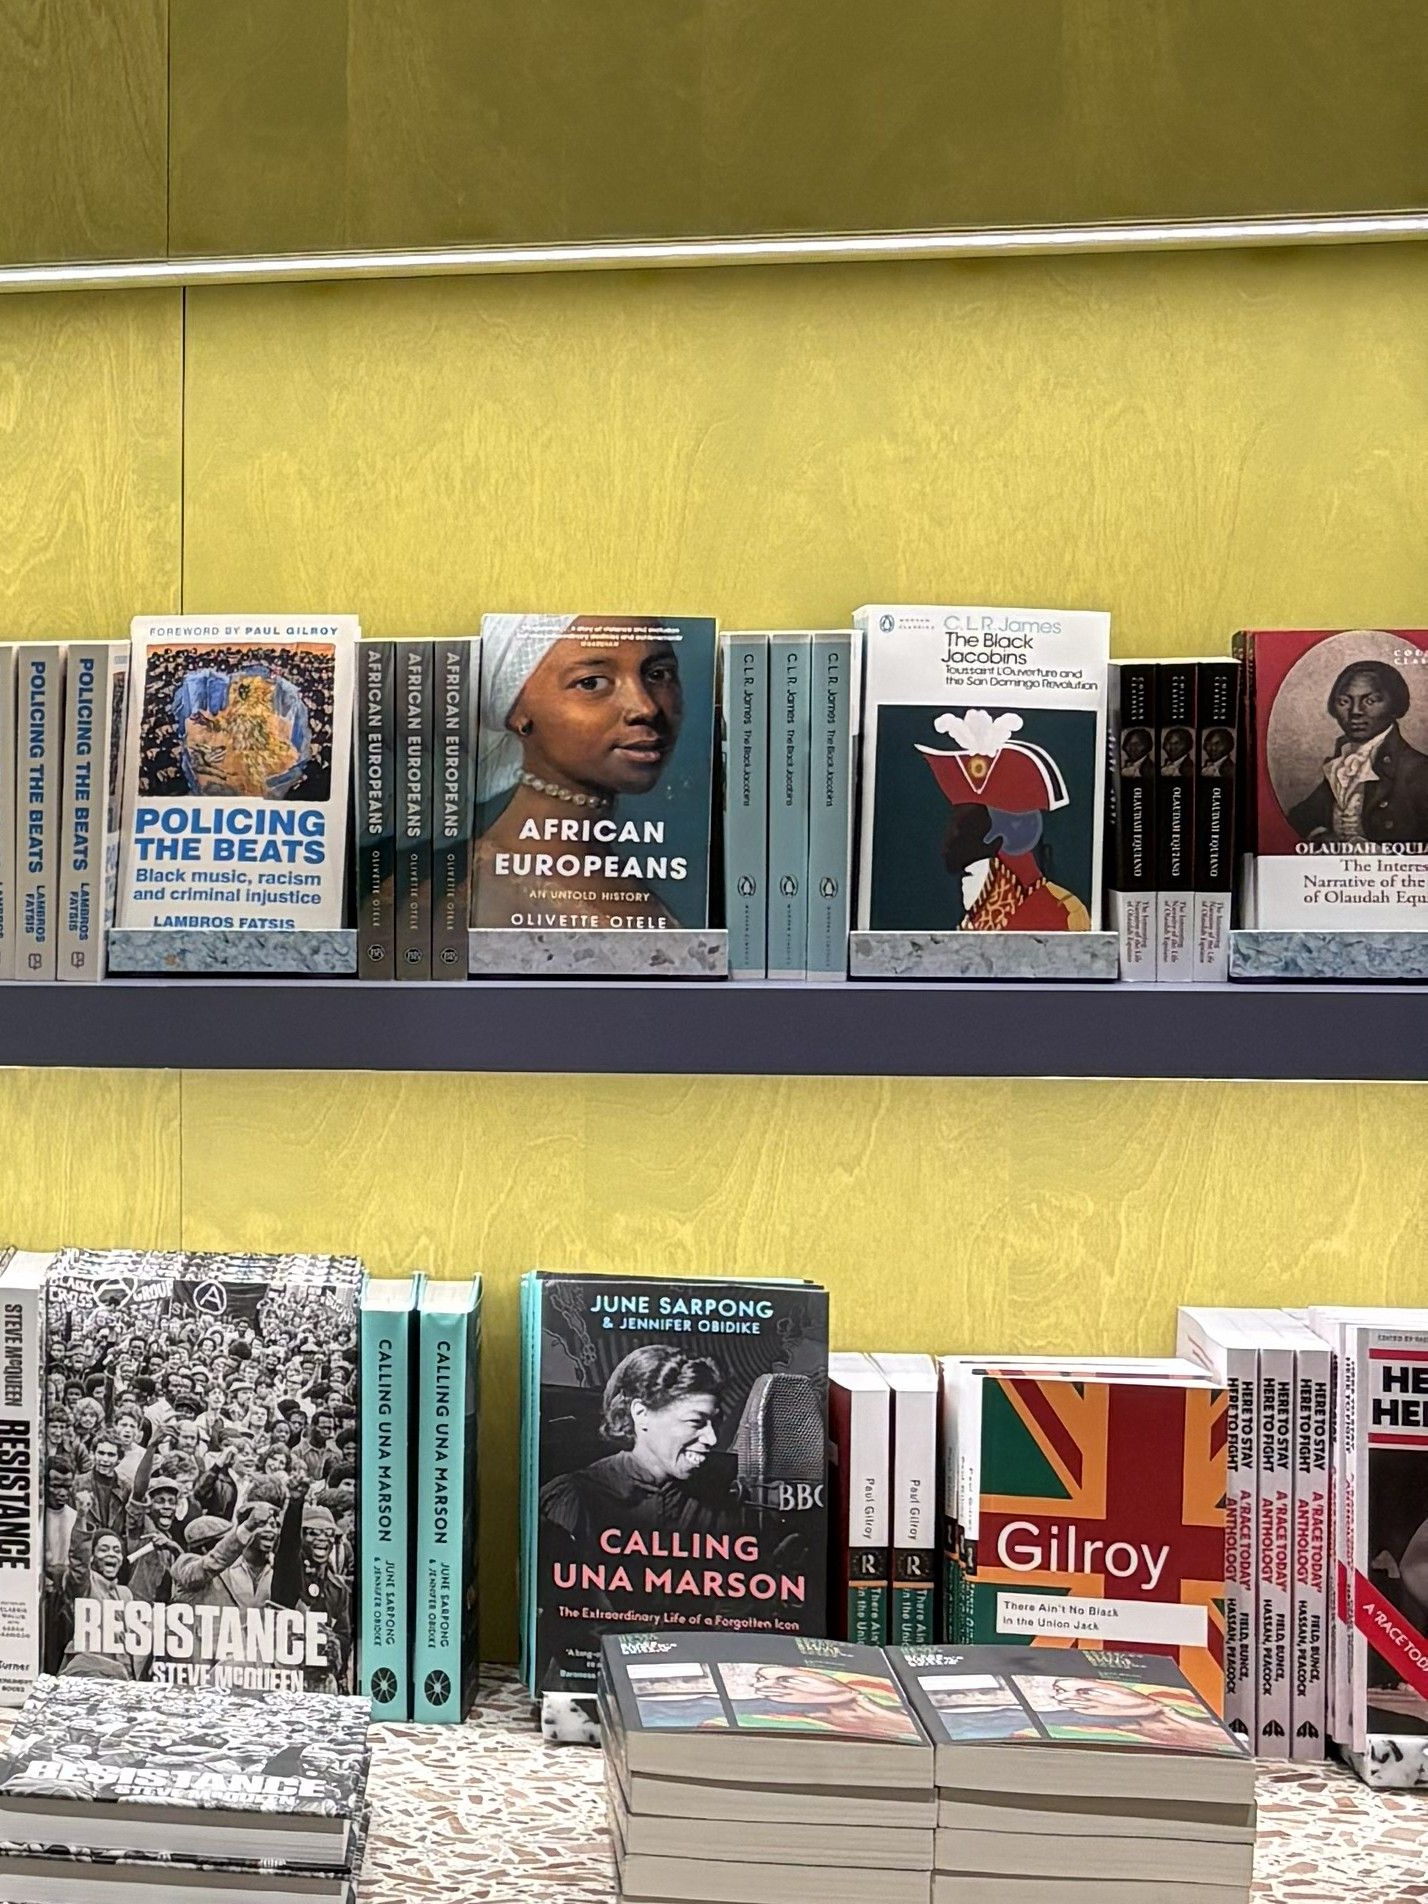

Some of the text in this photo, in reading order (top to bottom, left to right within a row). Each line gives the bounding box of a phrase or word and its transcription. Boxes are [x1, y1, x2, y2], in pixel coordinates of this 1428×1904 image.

[150, 626, 339, 636] FOREWORD BY PAUL GILROY
[945, 632, 1033, 650] The Black
[941, 649, 1027, 665] Jacobins
[367, 650, 383, 835] AFRICAN EUROPEANS
[135, 807, 326, 837] POLICING
[518, 818, 665, 844] AFRICAN
[134, 837, 325, 864] THE BEATS
[1295, 841, 1428, 856] OLAUDAH EQUI
[495, 853, 688, 880] EUROPEANS
[1340, 859, 1371, 872] The
[136, 868, 321, 887] Black music, racism
[1304, 875, 1425, 888] Narrative of the
[133, 887, 321, 905] and criminal injustice
[529, 891, 650, 902] AN UNTOLD HISTORY
[1304, 890, 1322, 904] of
[1330, 890, 1390, 904] Olaudah
[153, 915, 295, 929] LAMBROS FATSIS
[511, 913, 598, 927] OLIVETTE
[591, 1295, 775, 1319] JUNE SARPONG
[602, 1317, 761, 1335] & JENNIFER OBIDIKE
[1277, 1382, 1290, 1470] HERE TO STAY
[378, 1339, 392, 1543] CALLING UNA MARSON
[600, 1527, 760, 1561] CALLING
[997, 1521, 1170, 1590] Gilroy
[553, 1561, 807, 1601] UNA MARSON
[558, 1606, 800, 1630] The Extraordinary Life of a Forgotten Icon
[1003, 1601, 1119, 1617] There Ain't No Black
[73, 1597, 329, 1667] RESISTANCE
[1016, 1618, 1034, 1626] the
[1037, 1618, 1070, 1628] Union
[1073, 1620, 1099, 1631] Jack
[152, 1662, 304, 1692] STEVE McQUEEN
[25, 1759, 326, 1798] RESISTANCE
